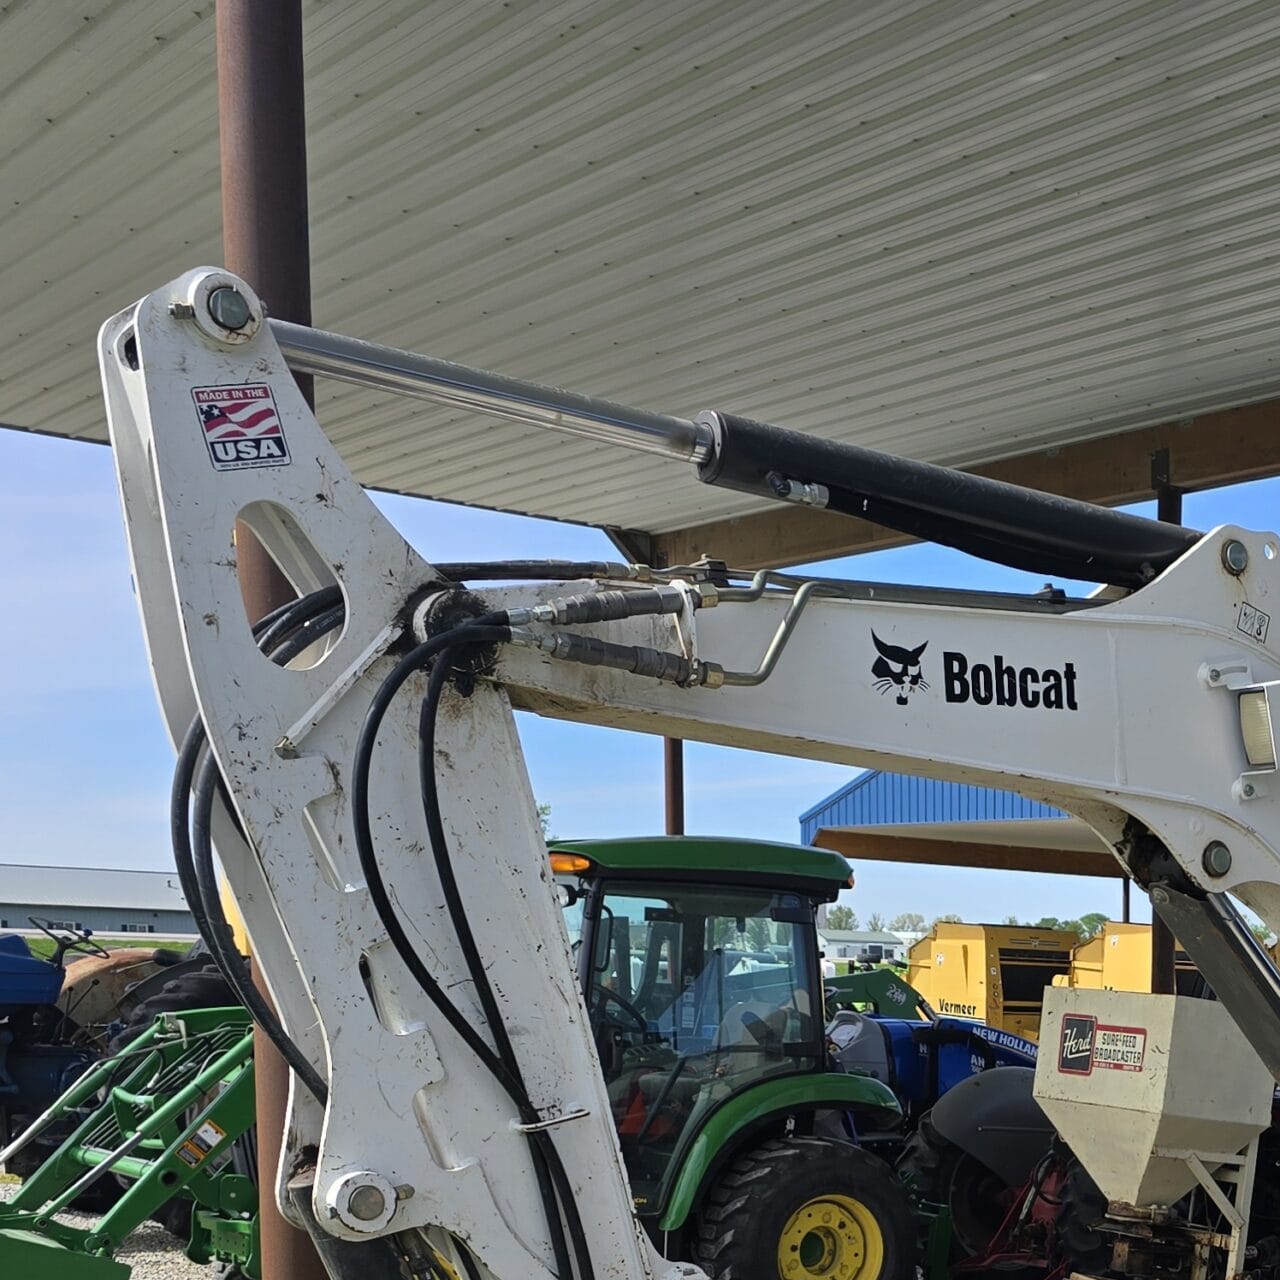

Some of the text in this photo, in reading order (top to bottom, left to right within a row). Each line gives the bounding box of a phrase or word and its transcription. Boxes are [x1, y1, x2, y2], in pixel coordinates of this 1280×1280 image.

[198, 388, 265, 401] MADE IN THE
[213, 439, 282, 461] USA
[943, 651, 1078, 711] Bobcat
[939, 998, 976, 1017] Vermeer
[973, 1026, 1038, 1059] NEW HOLLAN
[1094, 1047, 1141, 1064] BROADCASTER
